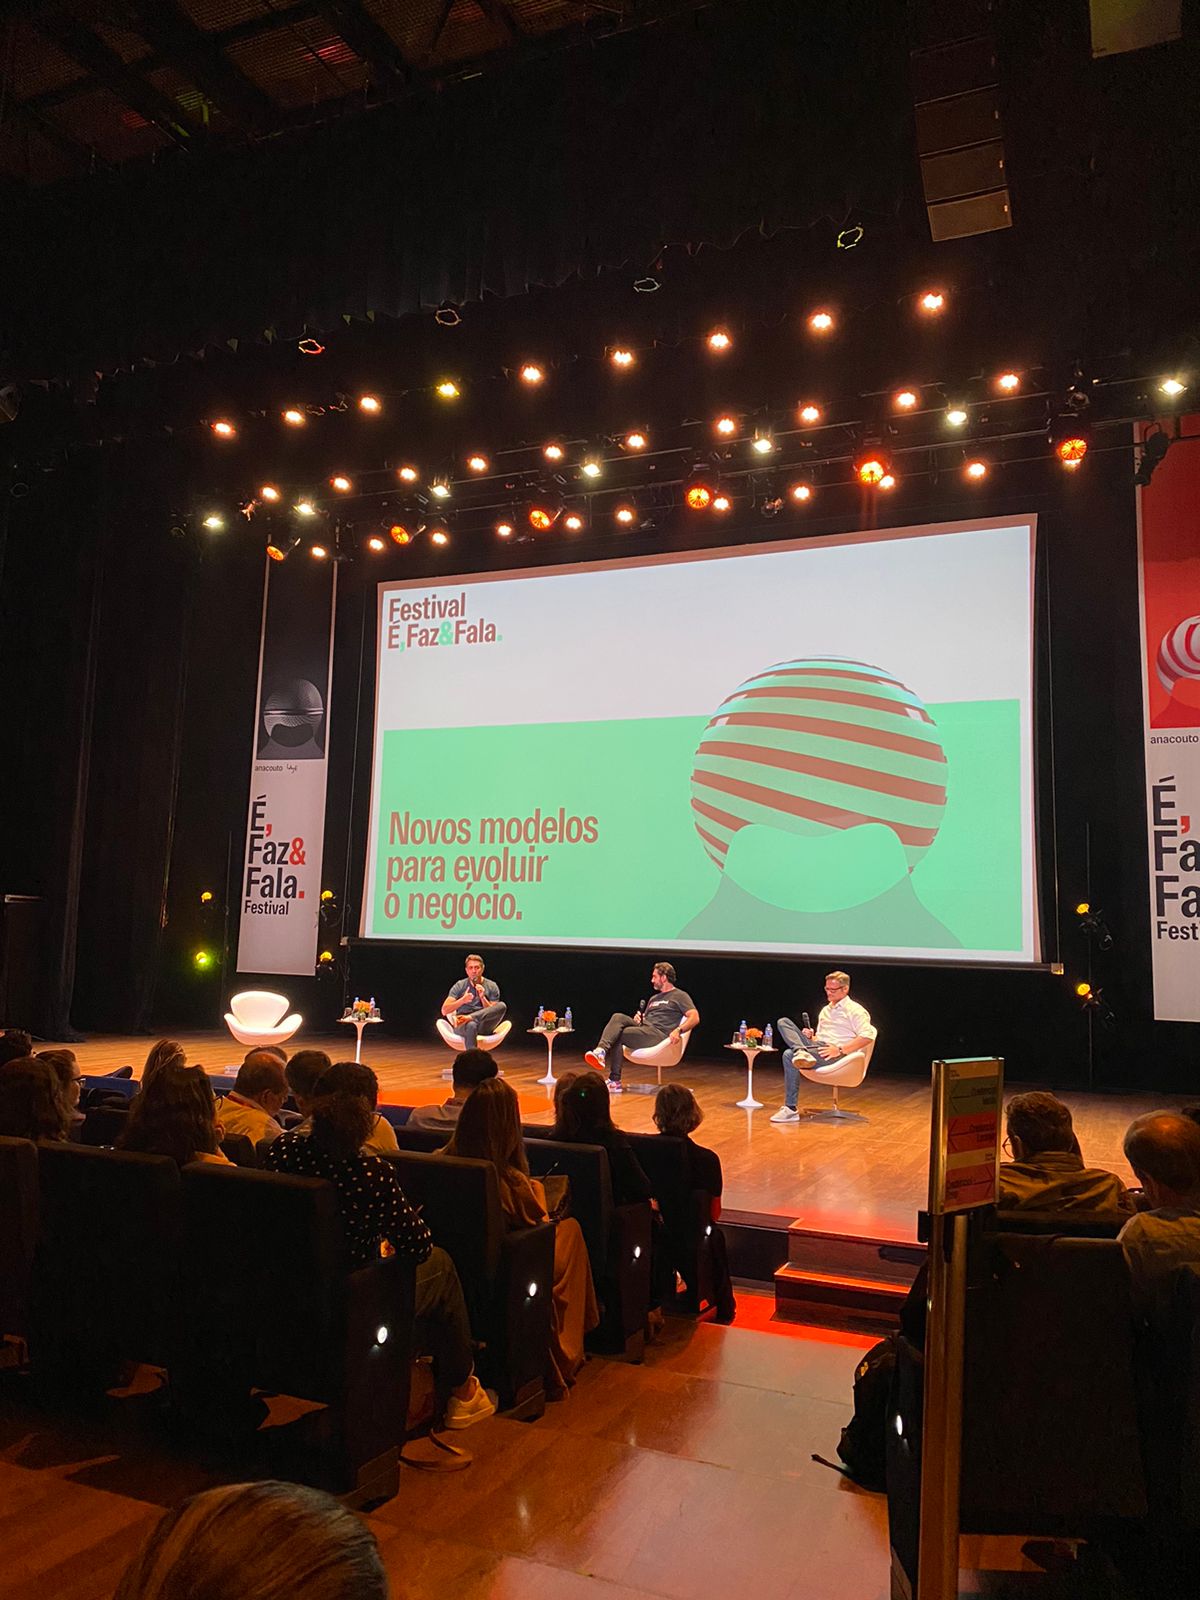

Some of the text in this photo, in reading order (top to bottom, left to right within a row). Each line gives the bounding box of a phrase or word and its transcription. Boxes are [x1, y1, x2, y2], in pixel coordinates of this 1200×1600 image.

[389, 592, 466, 622] Festival
[250, 794, 273, 837] É,
[1152, 776, 1190, 834] É,
[389, 807, 599, 845] Novos modelos
[248, 834, 306, 866] Faz&
[245, 867, 305, 899] Fala.
[386, 845, 549, 891] para evoluir
[244, 900, 289, 915] Festival
[384, 882, 522, 930] o negócio.
[1156, 921, 1200, 940] Fest
